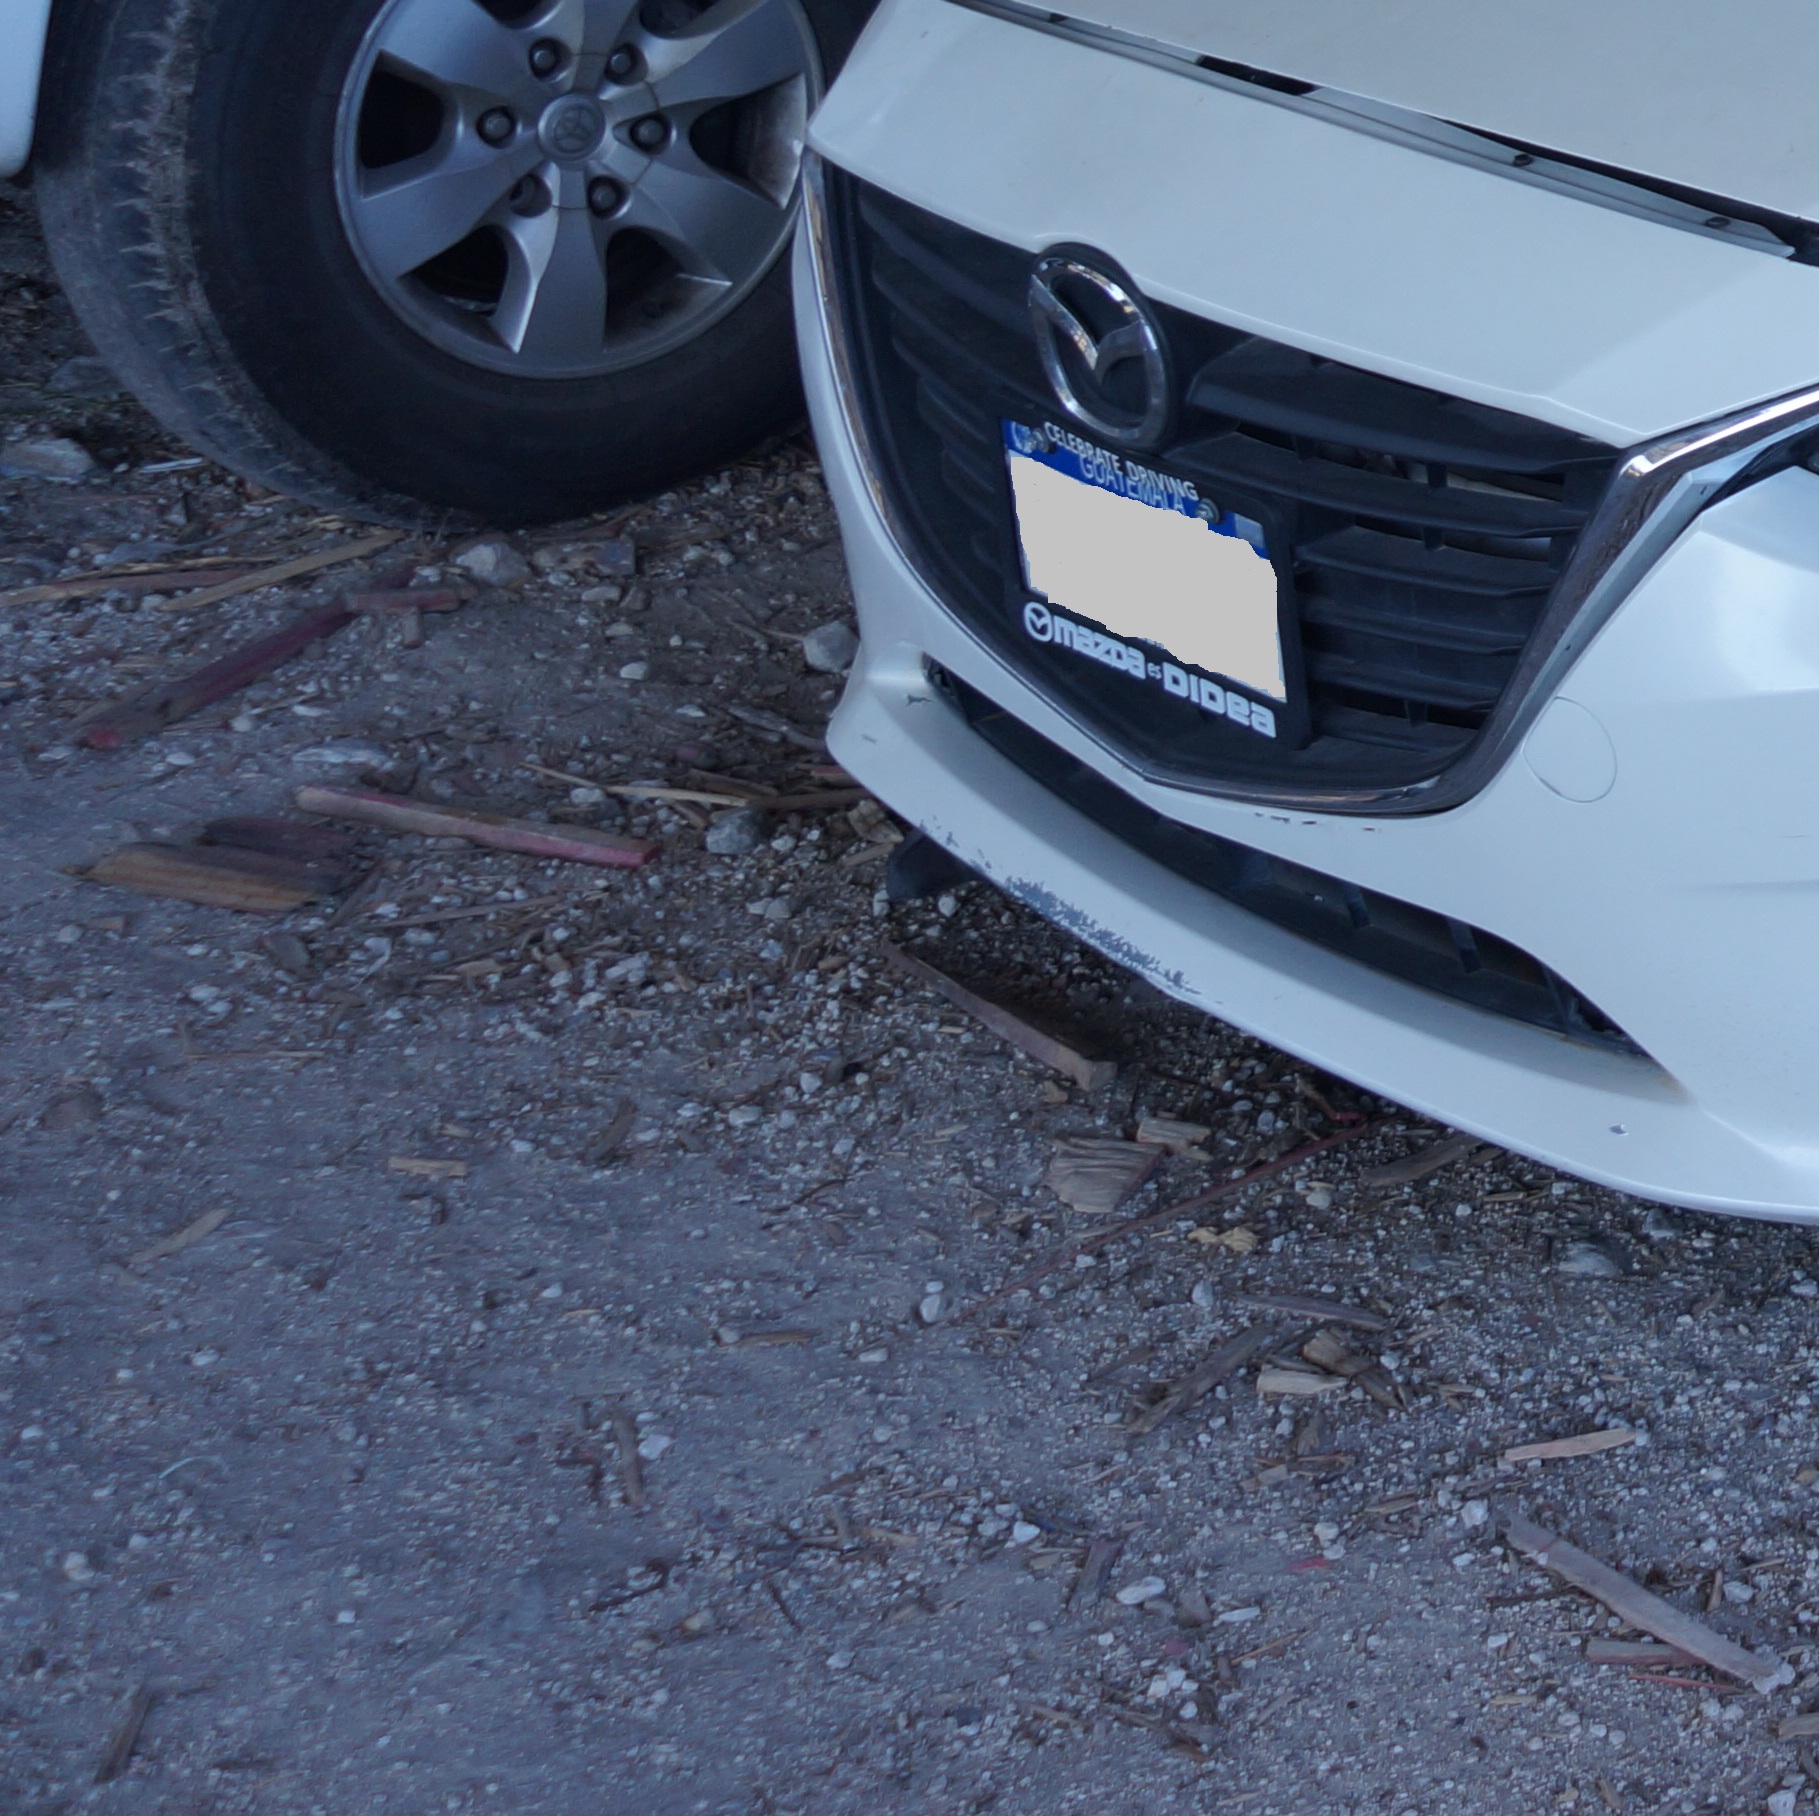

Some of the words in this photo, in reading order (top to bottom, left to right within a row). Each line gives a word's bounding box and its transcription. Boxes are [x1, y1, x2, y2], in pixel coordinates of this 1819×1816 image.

[1043, 421, 1124, 476] CELEBRATE
[1126, 460, 1199, 501] DRIVING
[1079, 453, 1187, 517] GUATEMALA
[1147, 661, 1162, 680] es
